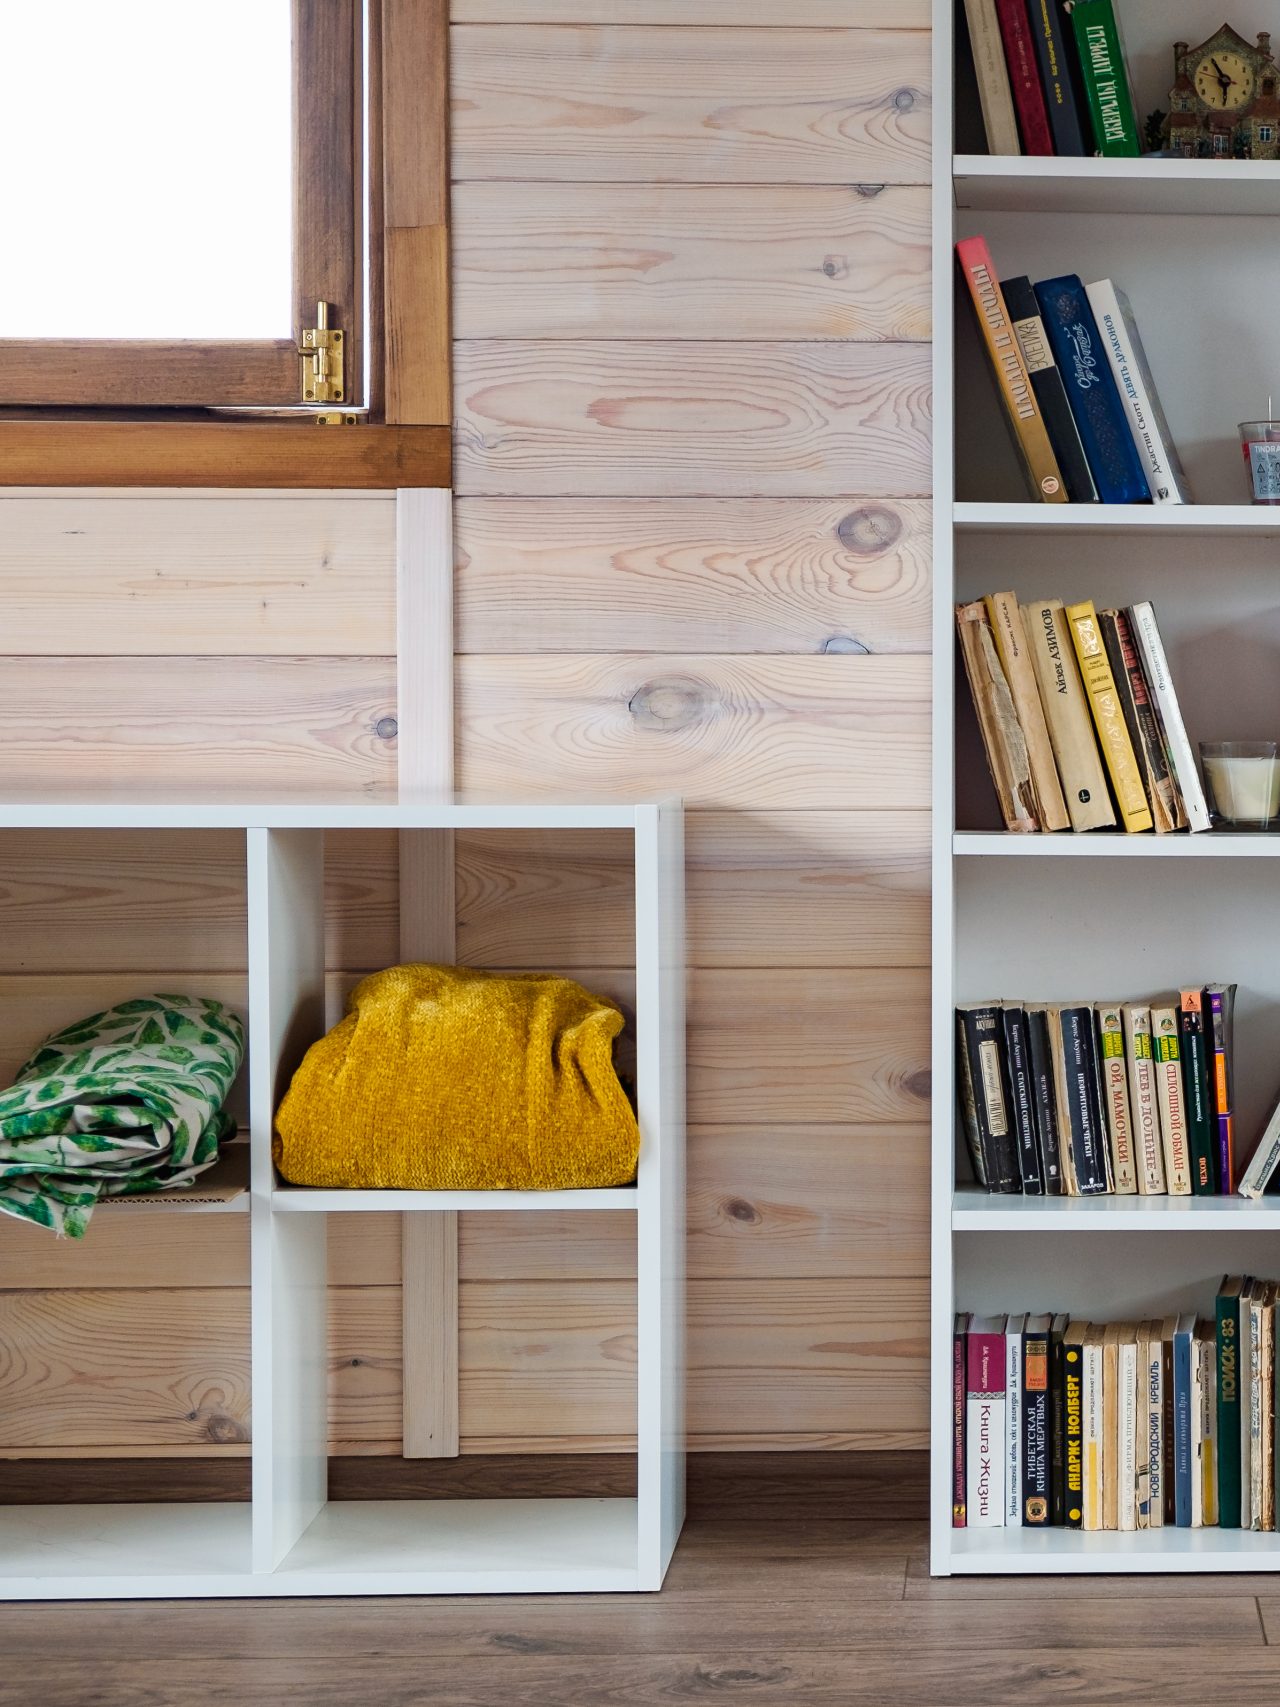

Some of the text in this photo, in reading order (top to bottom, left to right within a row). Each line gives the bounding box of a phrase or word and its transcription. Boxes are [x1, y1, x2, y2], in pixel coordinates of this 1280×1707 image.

[1085, 23, 1128, 145] ДЖЕРАЛЬД ДАРРЕЛЛ
[969, 262, 1040, 421] ПЛОДЫ И ЯГОДЫ
[1017, 319, 1049, 373] ЭСТЕТИКА
[1102, 313, 1163, 475] Джастин Скотт ДЕВЯТЬ ДРАКОНОВ
[1040, 608, 1069, 696] Айзек АЗИМОВ
[1010, 1024, 1021, 1044] Борис
[1016, 1071, 1029, 1109] СТАТСКИЙ
[1070, 1015, 1093, 1158] Борис Акунин НЕФРИТОВЫЕ ЧЕТКИ
[1108, 1062, 1125, 1088] ОЙ,
[1137, 1061, 1150, 1091] ЛЕВ
[1141, 1093, 1151, 1104] В
[1165, 1063, 1183, 1130] СПЛОШНОЙ
[1020, 1110, 1033, 1149] СОВЕТНИК
[1112, 1090, 1129, 1164] МАМОЧКИ!
[1139, 1105, 1157, 1171] ДОЛИНЕ
[1172, 1132, 1184, 1171] ОБМАН
[1199, 1157, 1208, 1185] ЧЕХОВ
[1221, 1318, 1235, 1402] ПОИСК 83
[1010, 1392, 1019, 1422] целомудрие
[1010, 1429, 1018, 1440] секс
[1036, 1394, 1045, 1451] МЕРТВЫХ
[1067, 1375, 1081, 1491] АНДРИС КОЛБЕРГ
[1150, 1361, 1160, 1498] НОВГОРОДСКИЙ КРЕМЛЬ
[978, 1405, 991, 1516] Книга Жизни
[1027, 1407, 1036, 1480] ТИБЕТСКАЯ
[1179, 1452, 1187, 1473] Дьявол
[1036, 1455, 1045, 1491] КНИГА
[1009, 1496, 1017, 1517] Зеркало
